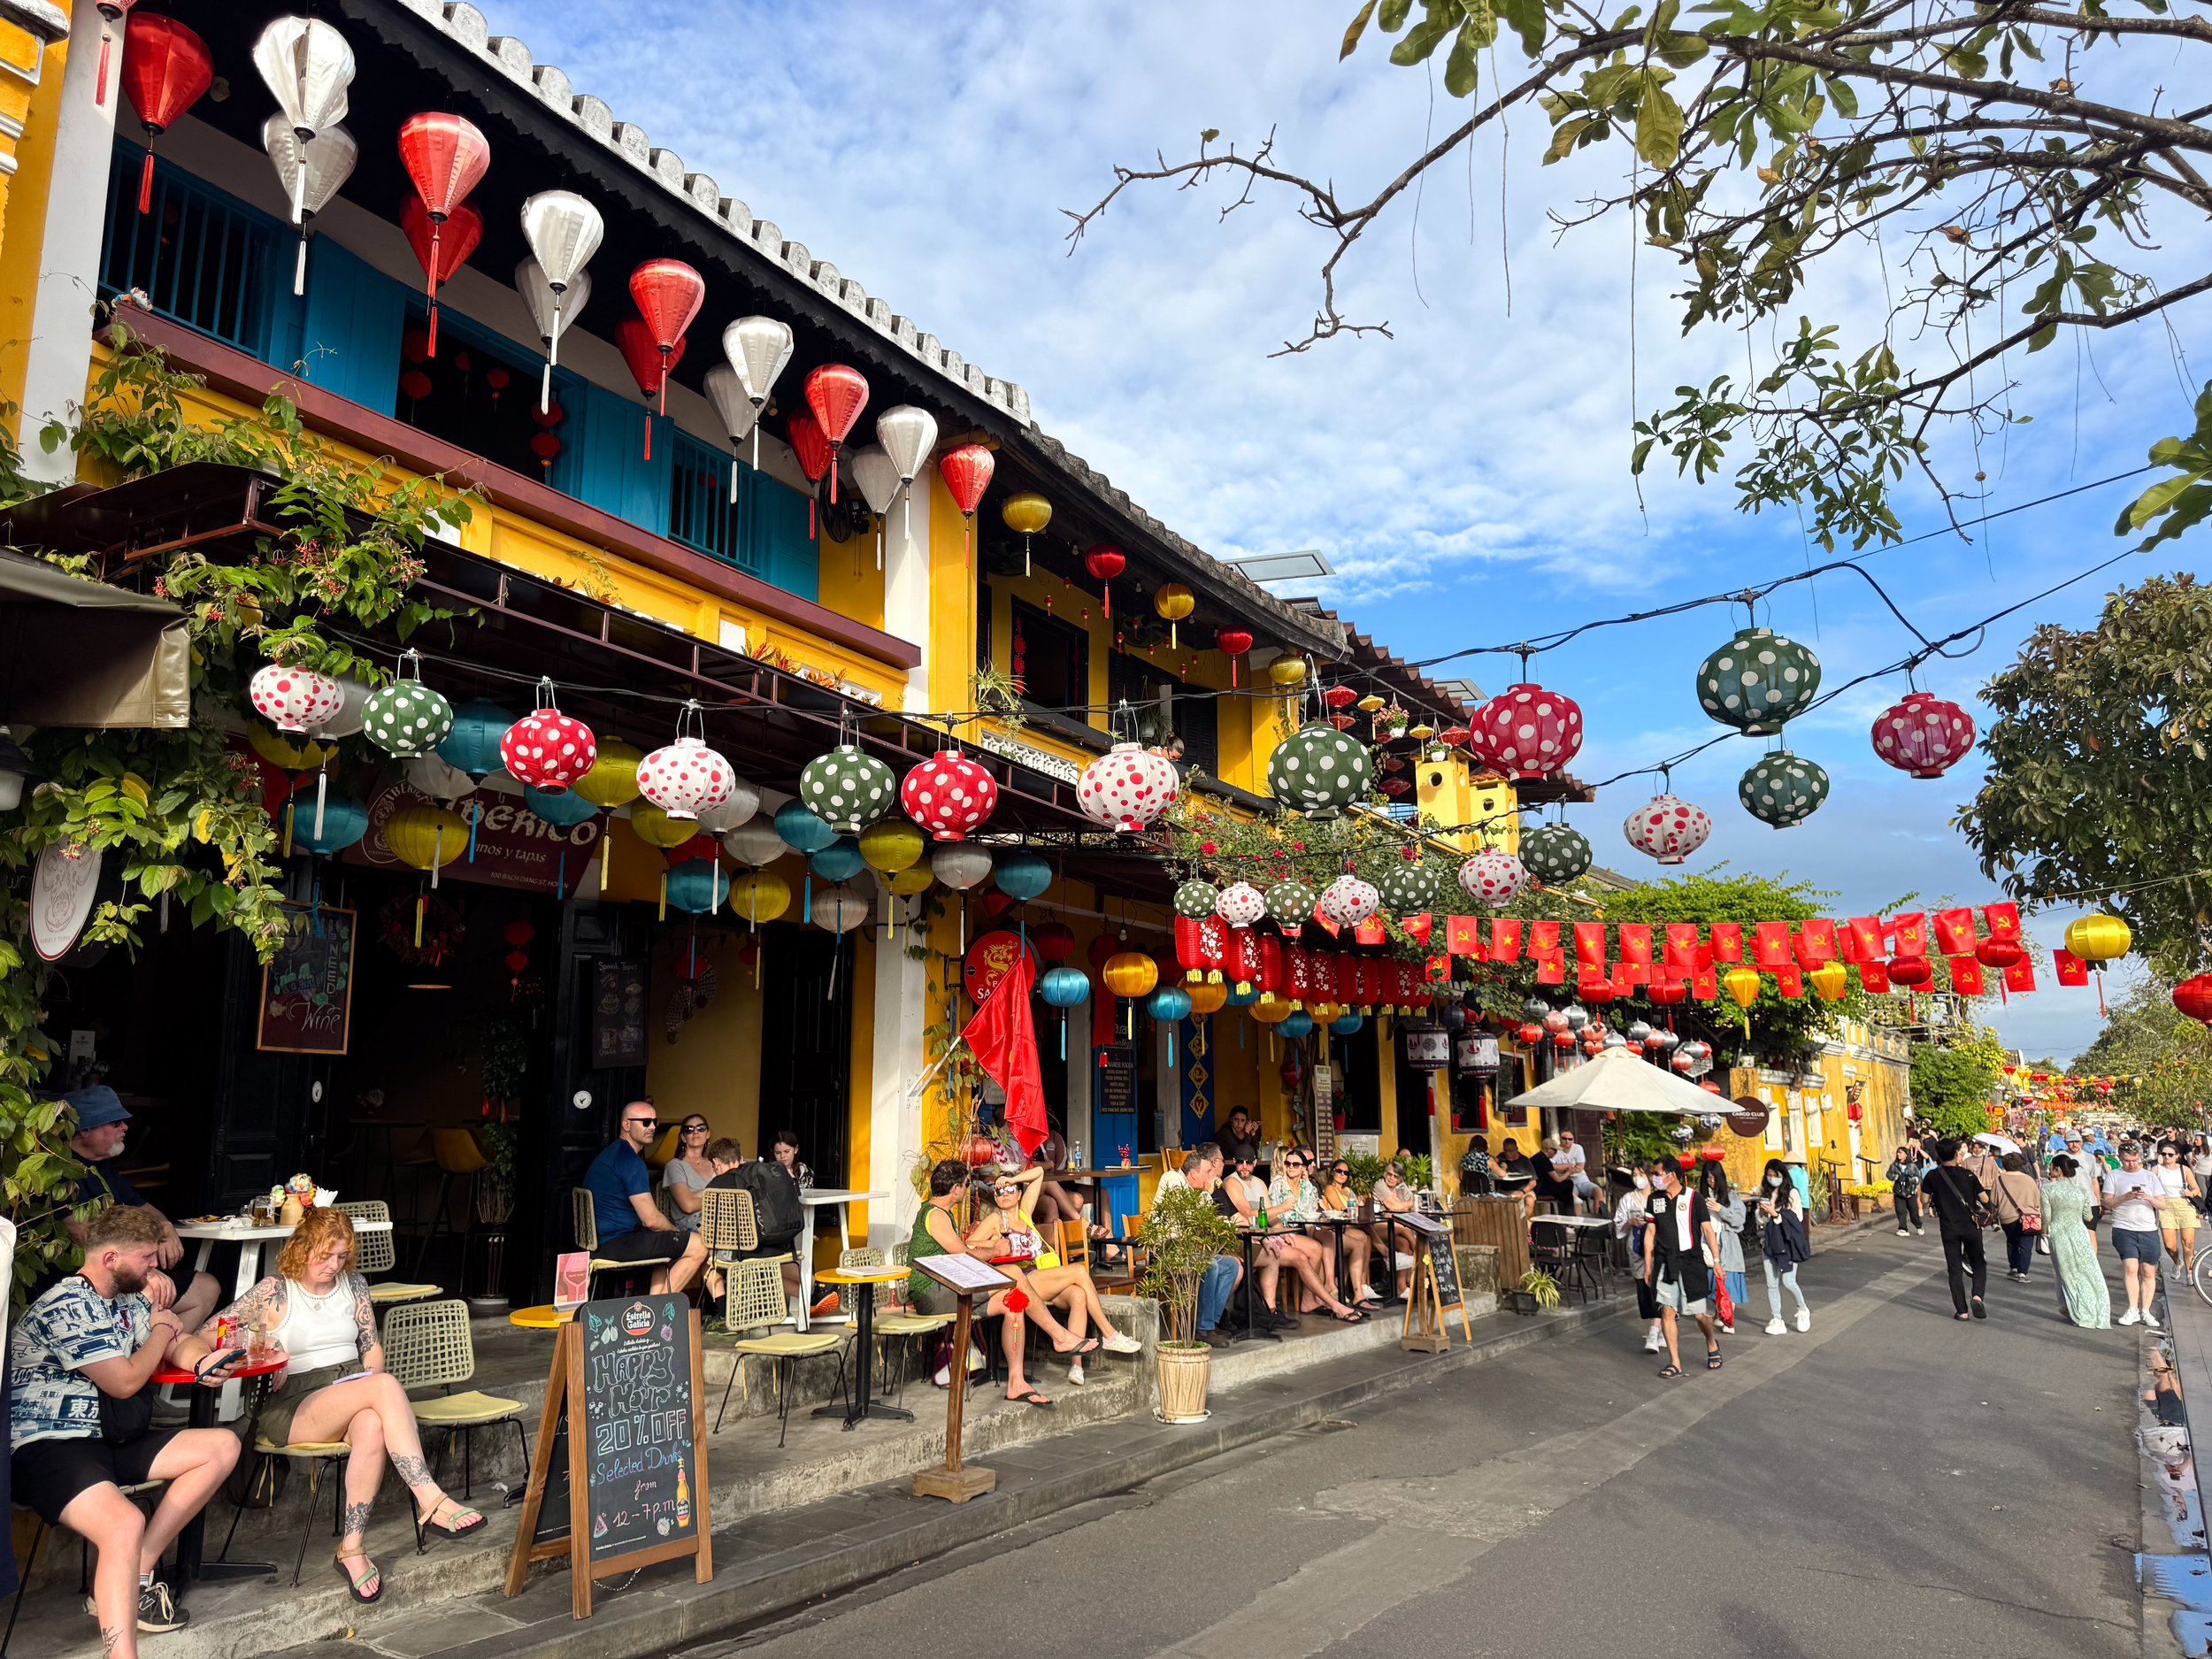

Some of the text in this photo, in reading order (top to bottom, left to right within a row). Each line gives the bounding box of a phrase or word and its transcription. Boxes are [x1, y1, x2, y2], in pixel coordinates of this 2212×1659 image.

[516, 847, 547, 864] tapas
[626, 1310, 651, 1321] Estrella
[627, 1318, 650, 1330] Galicia
[650, 1409, 687, 1444] OFF
[596, 1451, 644, 1486] Selected
[634, 1479, 657, 1501] from
